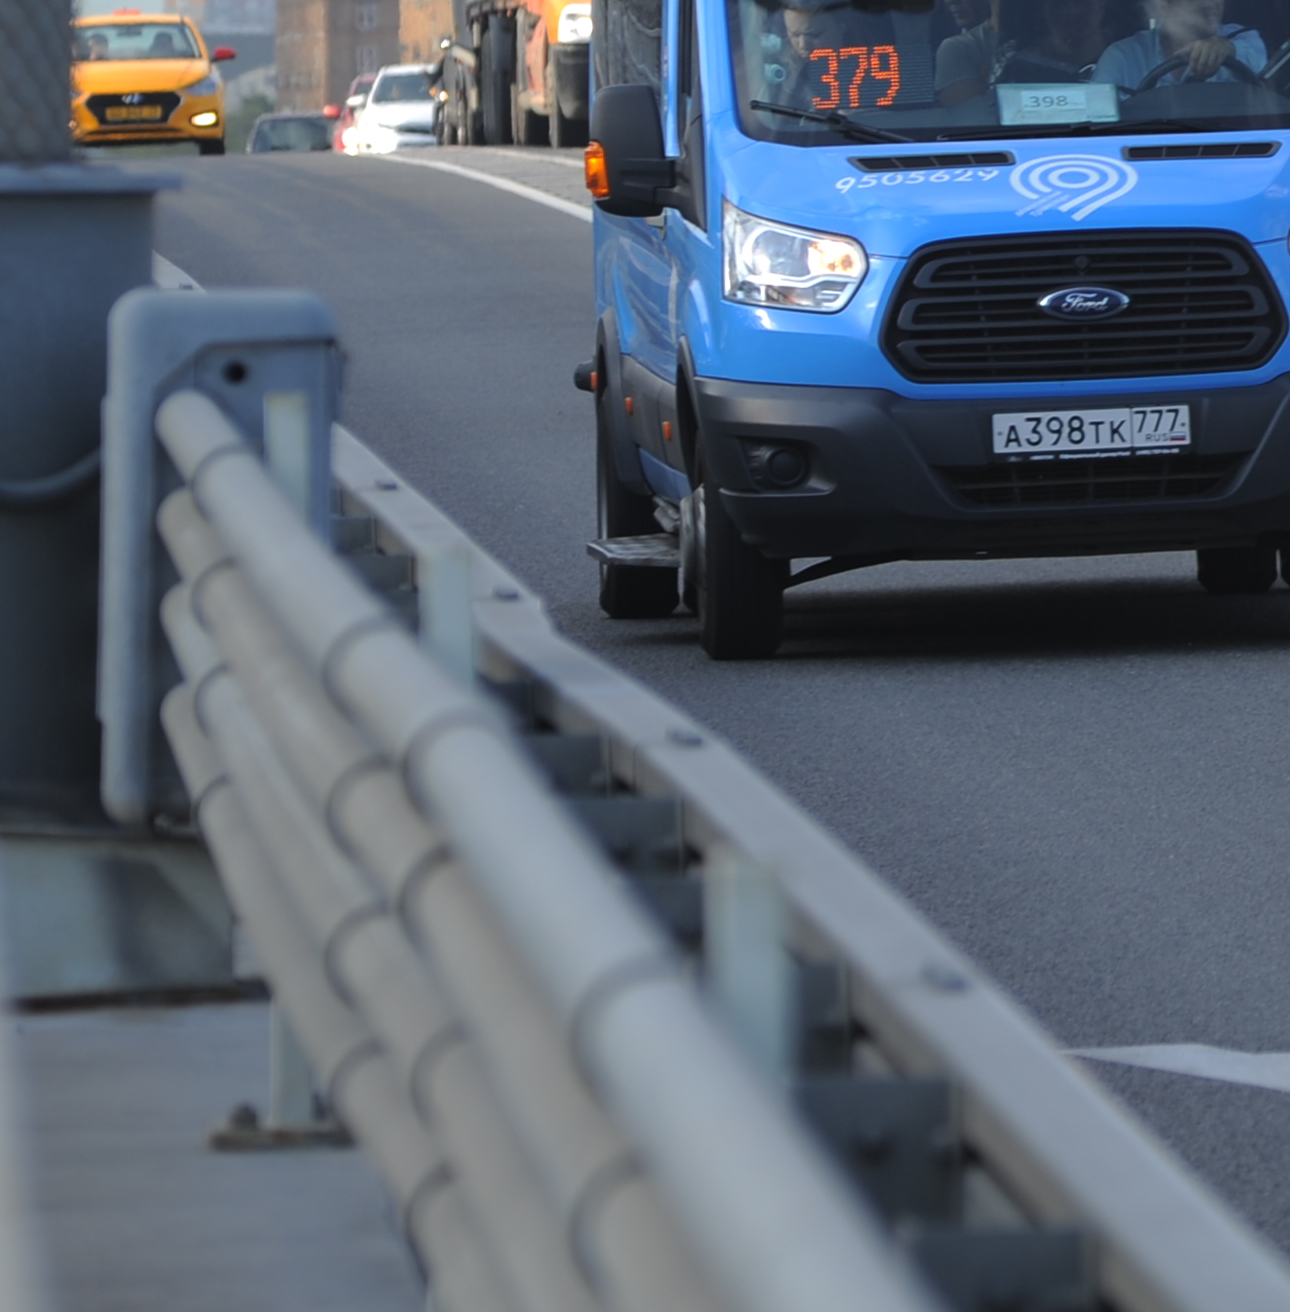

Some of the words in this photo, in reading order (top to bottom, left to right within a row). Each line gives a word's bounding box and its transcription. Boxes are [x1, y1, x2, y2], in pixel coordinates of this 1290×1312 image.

[810, 45, 900, 109] 379
[1028, 94, 1069, 109] 398
[1061, 292, 1110, 312] Ford
[1004, 415, 1127, 449] А398ТК
[1133, 408, 1180, 434] 777
[1144, 432, 1170, 442] RUS
